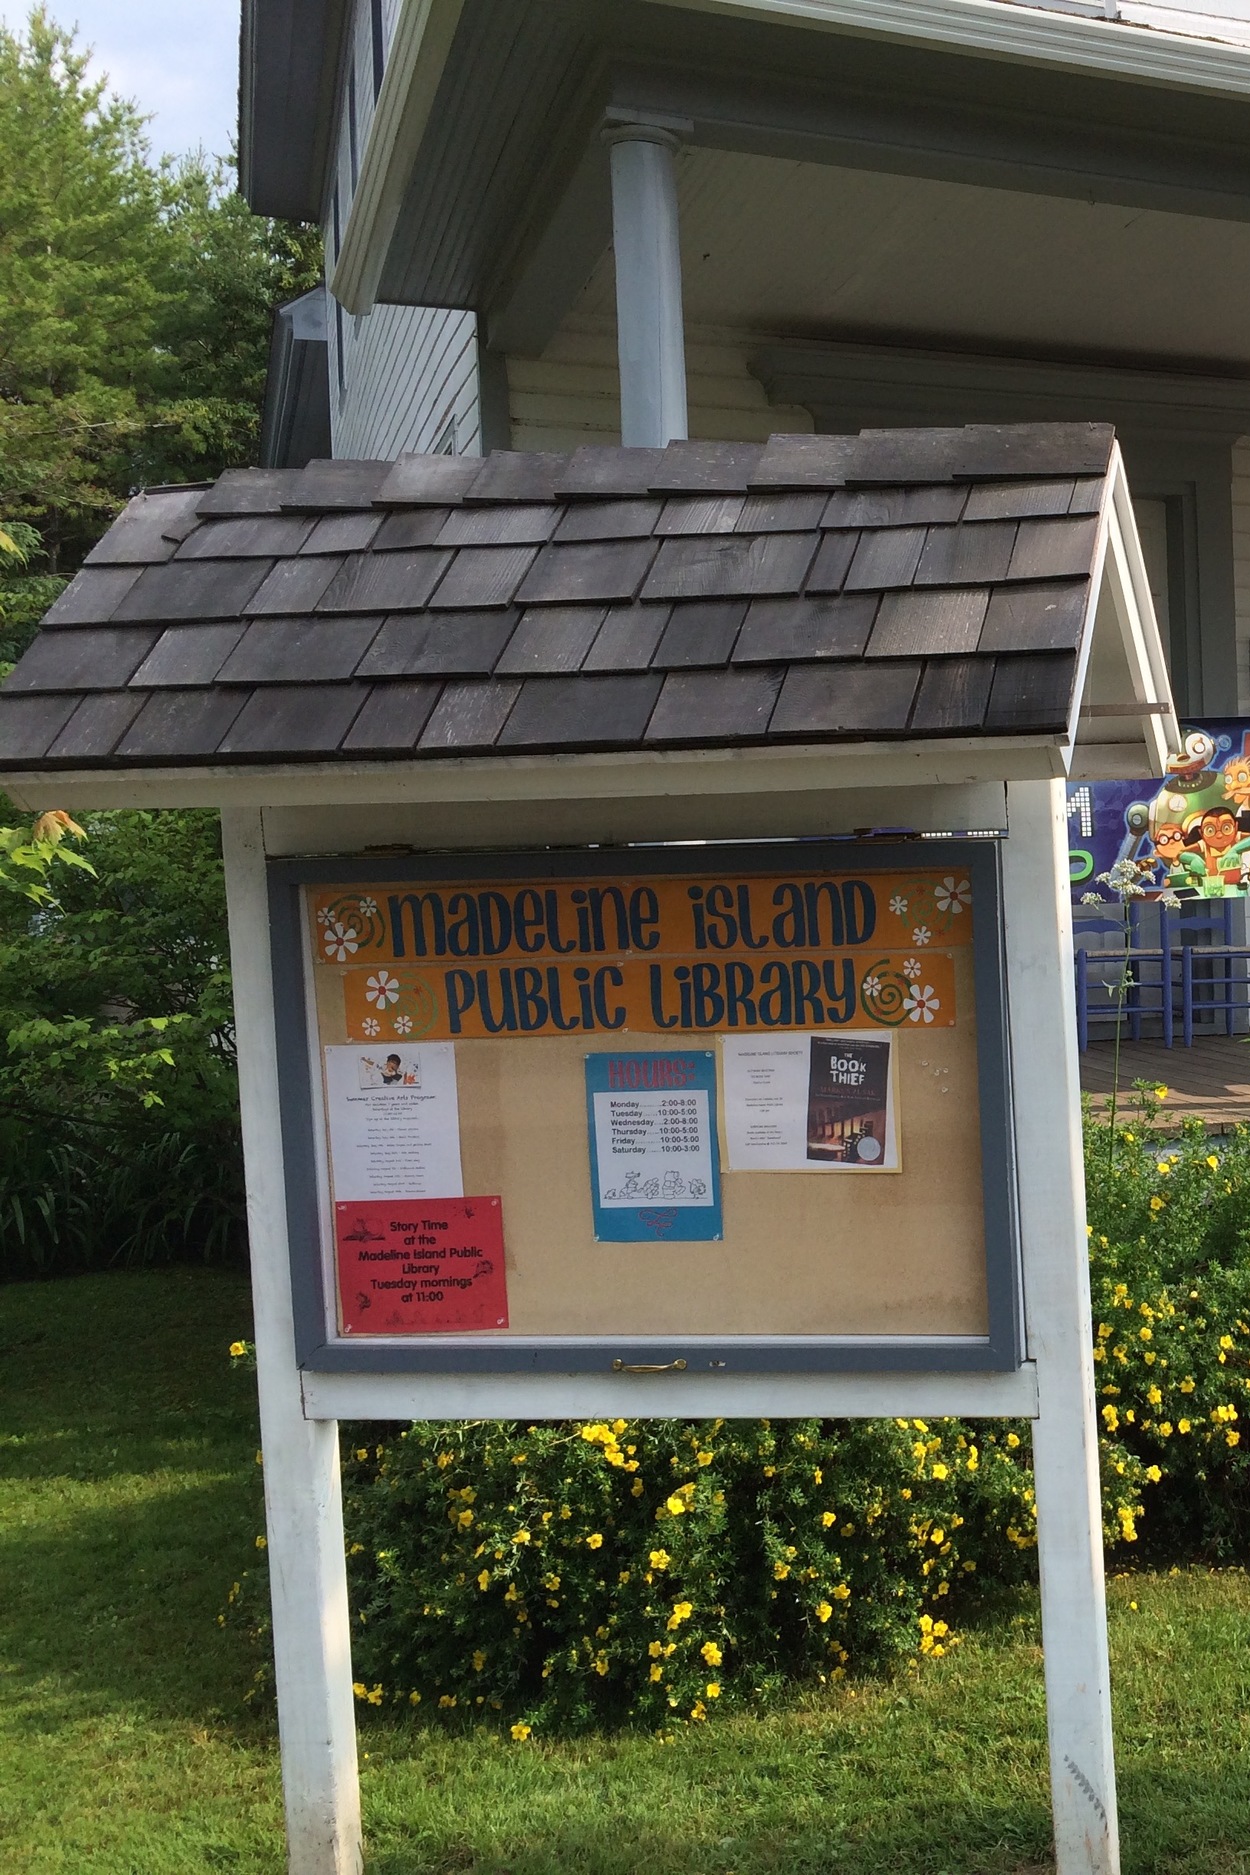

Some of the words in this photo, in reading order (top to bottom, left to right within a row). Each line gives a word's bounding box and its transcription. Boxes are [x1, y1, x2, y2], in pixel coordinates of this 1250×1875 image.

[830, 1056, 867, 1073] BOOK
[609, 1059, 696, 1089] HOURS:
[830, 1070, 865, 1085] THIEF
[610, 1101, 639, 1109] Monday
[611, 1110, 643, 1118] Tuesday
[611, 1119, 654, 1127] Wednesday
[612, 1128, 647, 1136] Thursday
[612, 1137, 636, 1145] Friday
[612, 1146, 646, 1155] Saturday
[390, 1221, 418, 1233] Story
[421, 1220, 448, 1230] Time
[404, 1235, 415, 1245] at
[418, 1234, 436, 1244] the
[358, 1250, 411, 1261] Madeline
[413, 1248, 446, 1259] Island
[450, 1247, 483, 1258] Public
[402, 1264, 439, 1275] Library
[370, 1279, 417, 1290] Tuesday
[420, 1276, 472, 1289] mornings
[401, 1293, 412, 1302] at
[416, 1291, 443, 1302] 11:00
